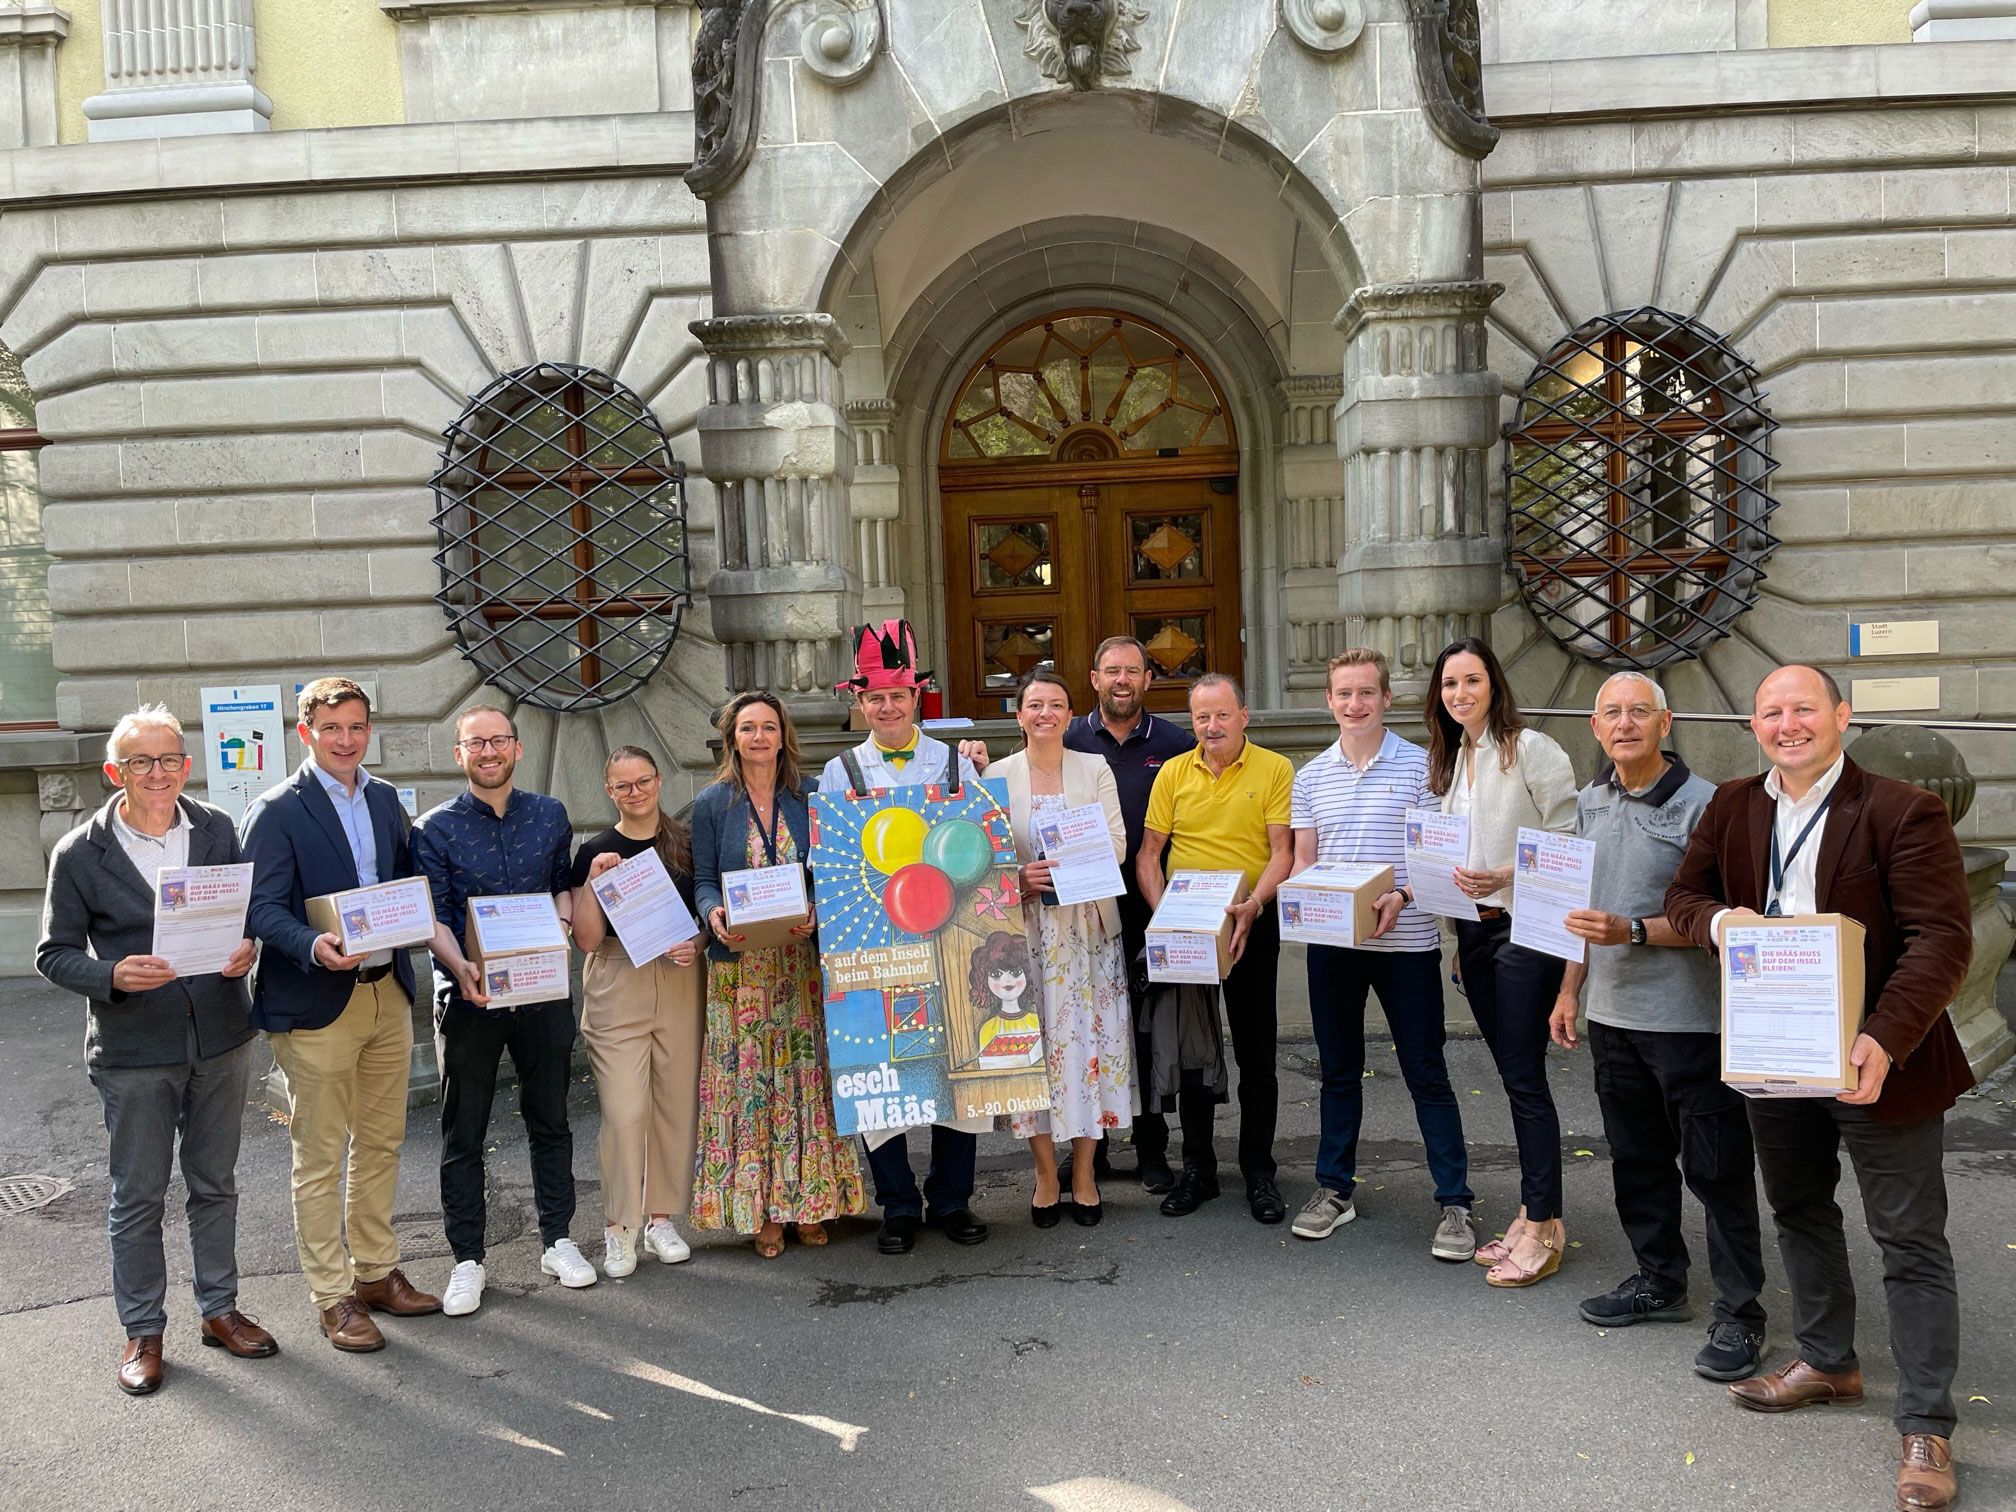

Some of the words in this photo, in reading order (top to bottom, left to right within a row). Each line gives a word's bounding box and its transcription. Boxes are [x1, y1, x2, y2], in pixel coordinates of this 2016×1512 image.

[835, 953, 857, 968] auf
[860, 951, 888, 964] dem
[891, 944, 931, 960] Inseli
[835, 969, 870, 984] beim
[872, 960, 928, 979] Bahnhof
[837, 1063, 900, 1099] esch
[855, 1095, 937, 1132] Määs
